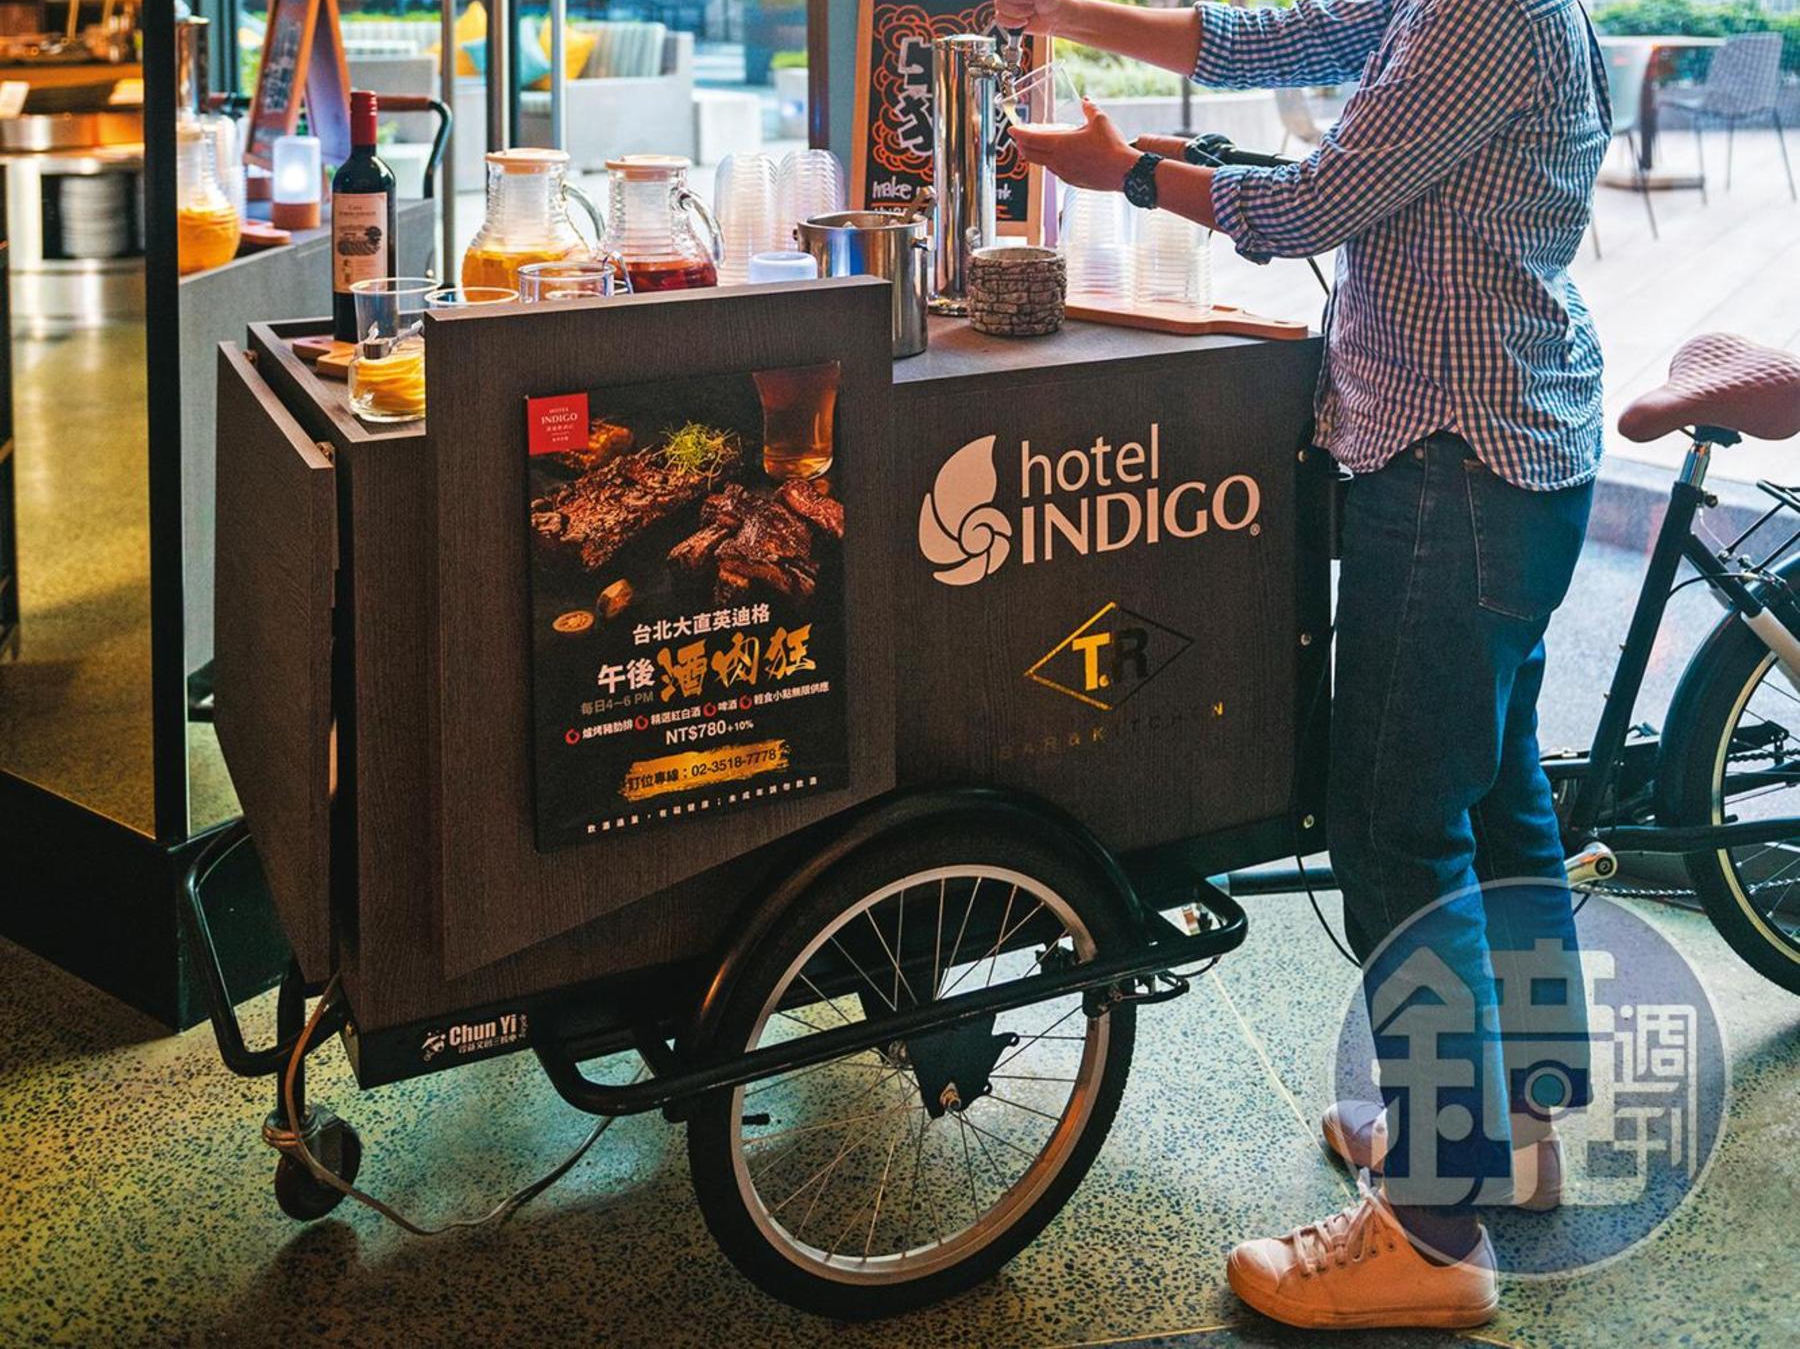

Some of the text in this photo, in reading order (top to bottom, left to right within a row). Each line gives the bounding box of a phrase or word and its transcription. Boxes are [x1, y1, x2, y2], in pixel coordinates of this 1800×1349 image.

[541, 412, 578, 425] INDIGO
[1021, 423, 1159, 499] hotel
[1022, 474, 1261, 564] INDIGO
[632, 603, 770, 645] 台北大直英迪格
[597, 658, 655, 694] 午後
[449, 1021, 497, 1046] Chun
[500, 1014, 517, 1036] Yi
